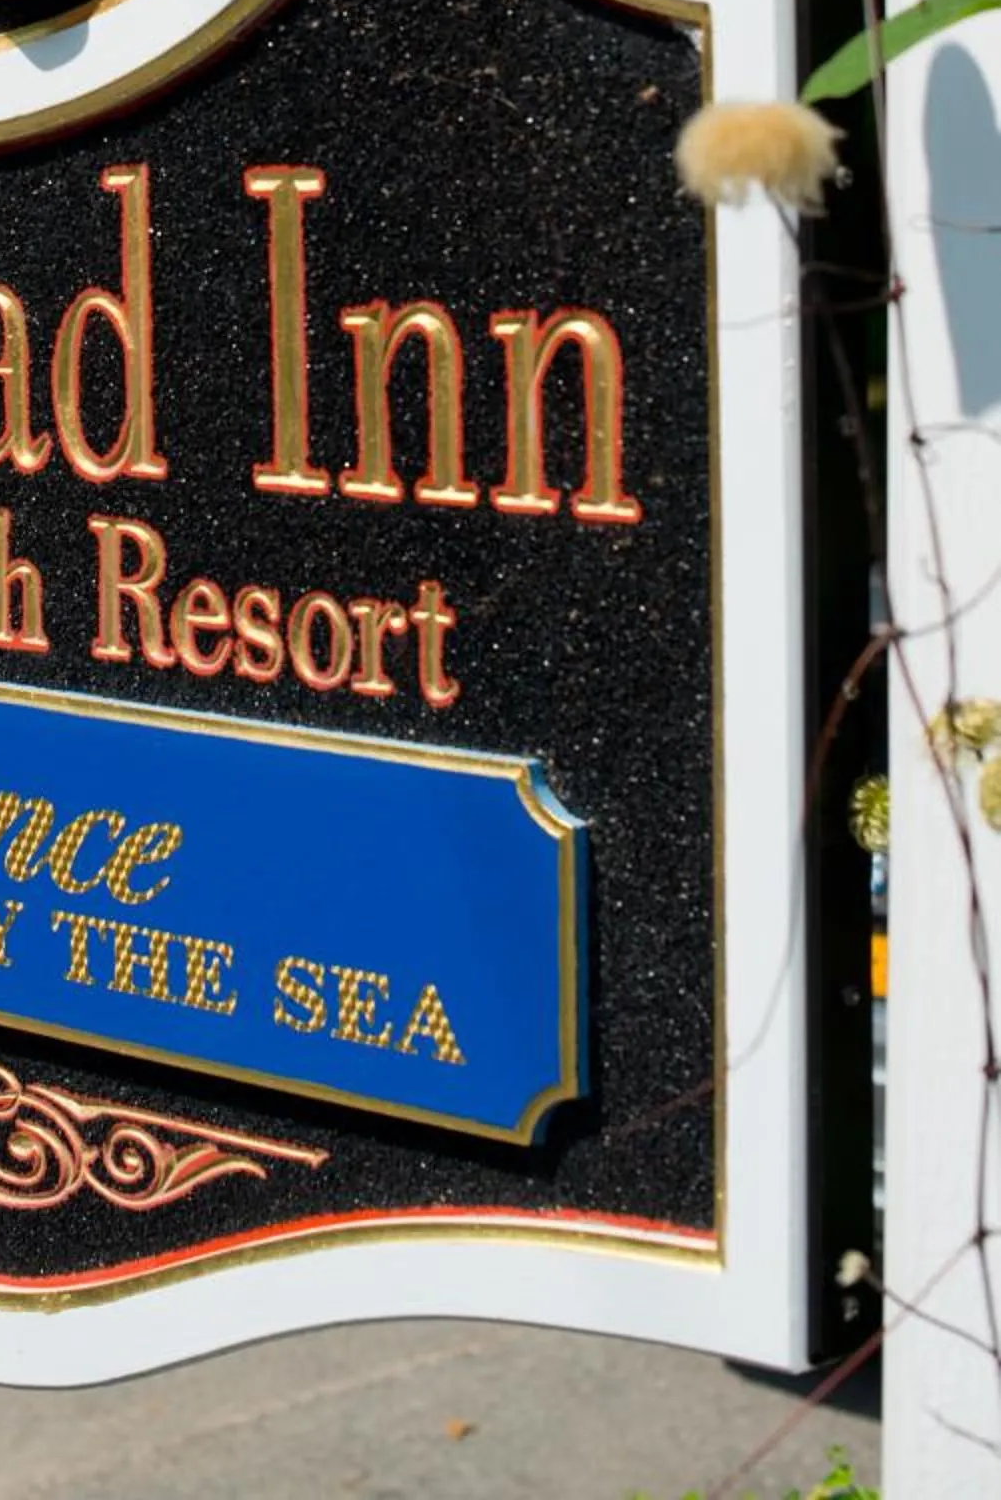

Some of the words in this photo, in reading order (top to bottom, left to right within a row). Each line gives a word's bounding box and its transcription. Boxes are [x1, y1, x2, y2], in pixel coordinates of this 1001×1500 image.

[243, 163, 643, 523] Inn
[89, 513, 460, 708] Resort
[51, 910, 237, 1016] THE
[273, 955, 467, 1066] SEA
